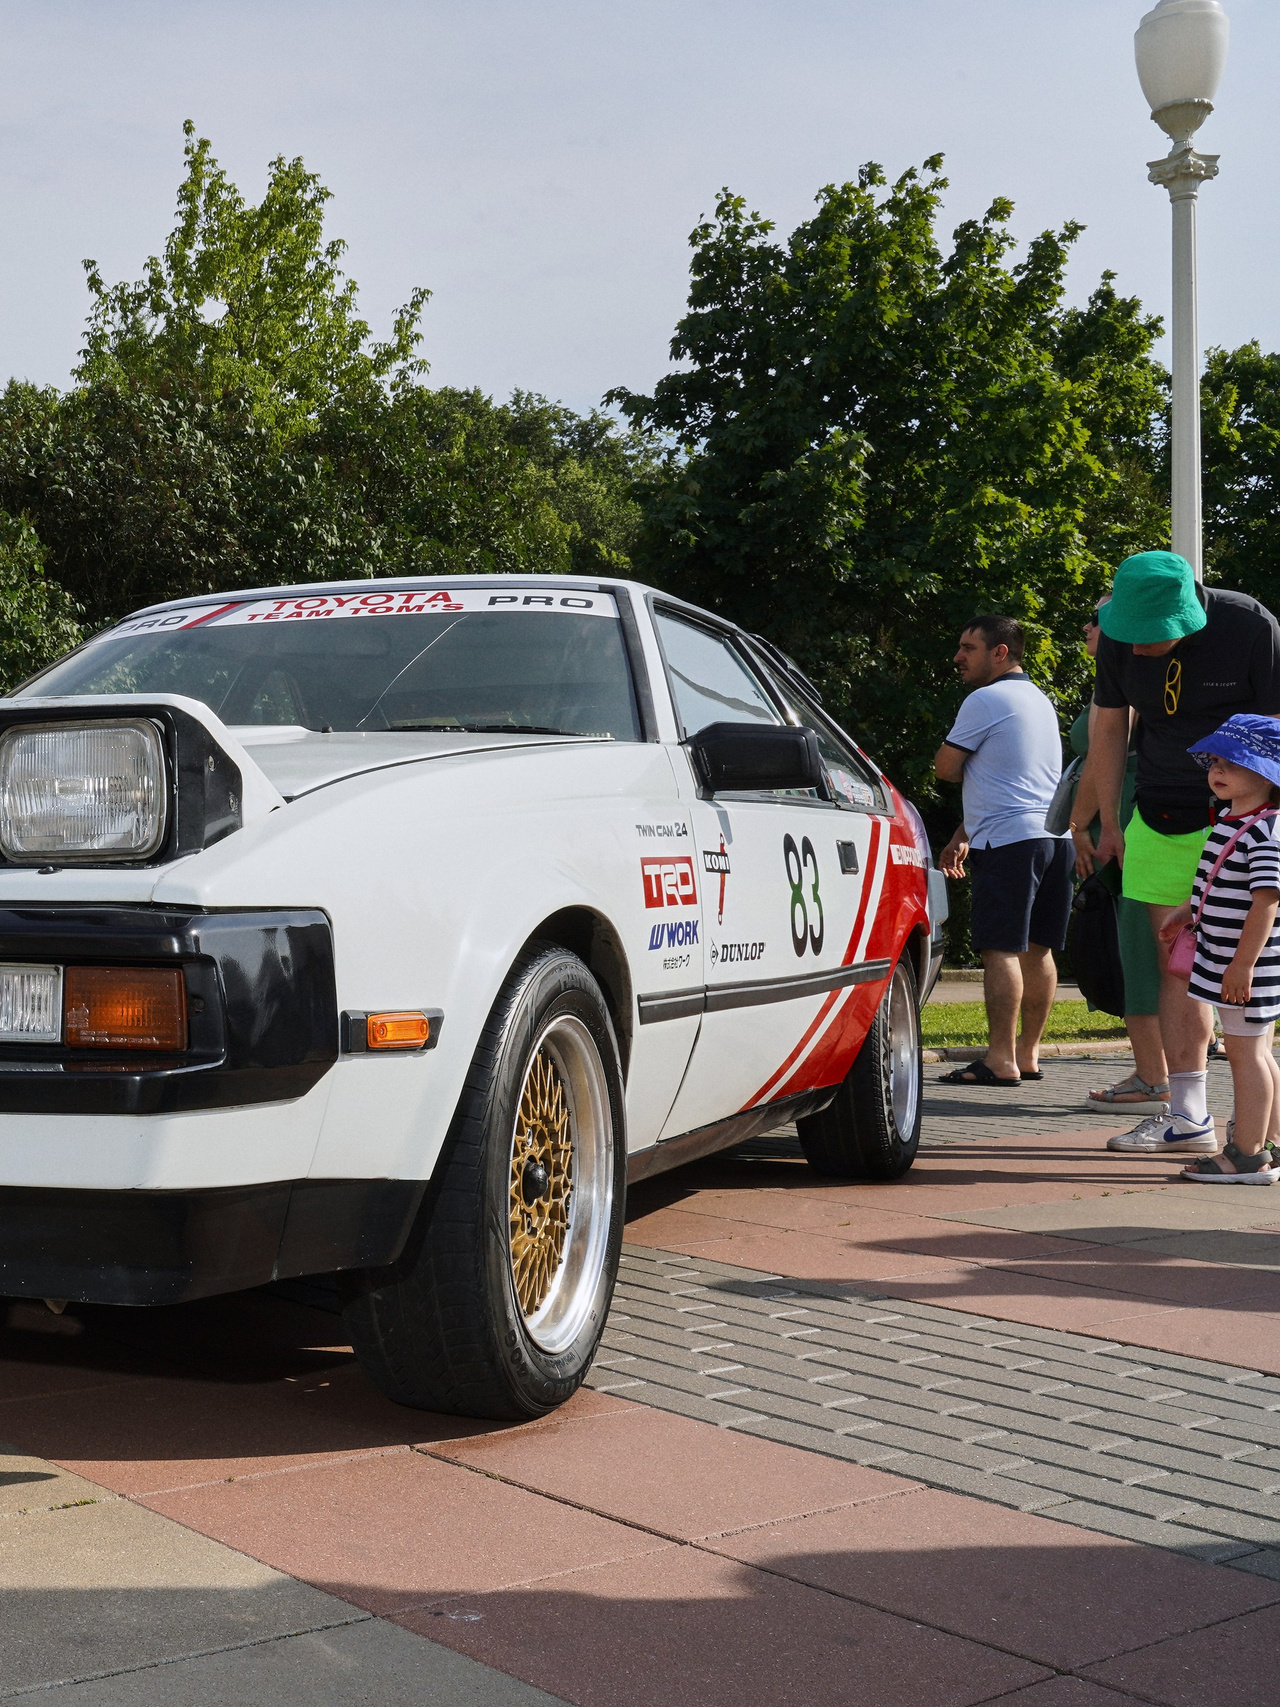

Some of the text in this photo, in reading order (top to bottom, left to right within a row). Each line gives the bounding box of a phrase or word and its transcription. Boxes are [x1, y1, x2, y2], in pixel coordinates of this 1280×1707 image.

[272, 591, 454, 612] TOYOTA
[487, 595, 594, 609] PRO
[246, 603, 465, 622] TEAM TOM'S
[115, 616, 188, 637] PRO
[635, 822, 688, 837] TWIN CAM 24
[704, 853, 730, 870] KONI
[643, 862, 694, 907] TRD
[783, 833, 824, 957] 83
[666, 920, 699, 948] WORK
[720, 942, 765, 962] DUNLOP
